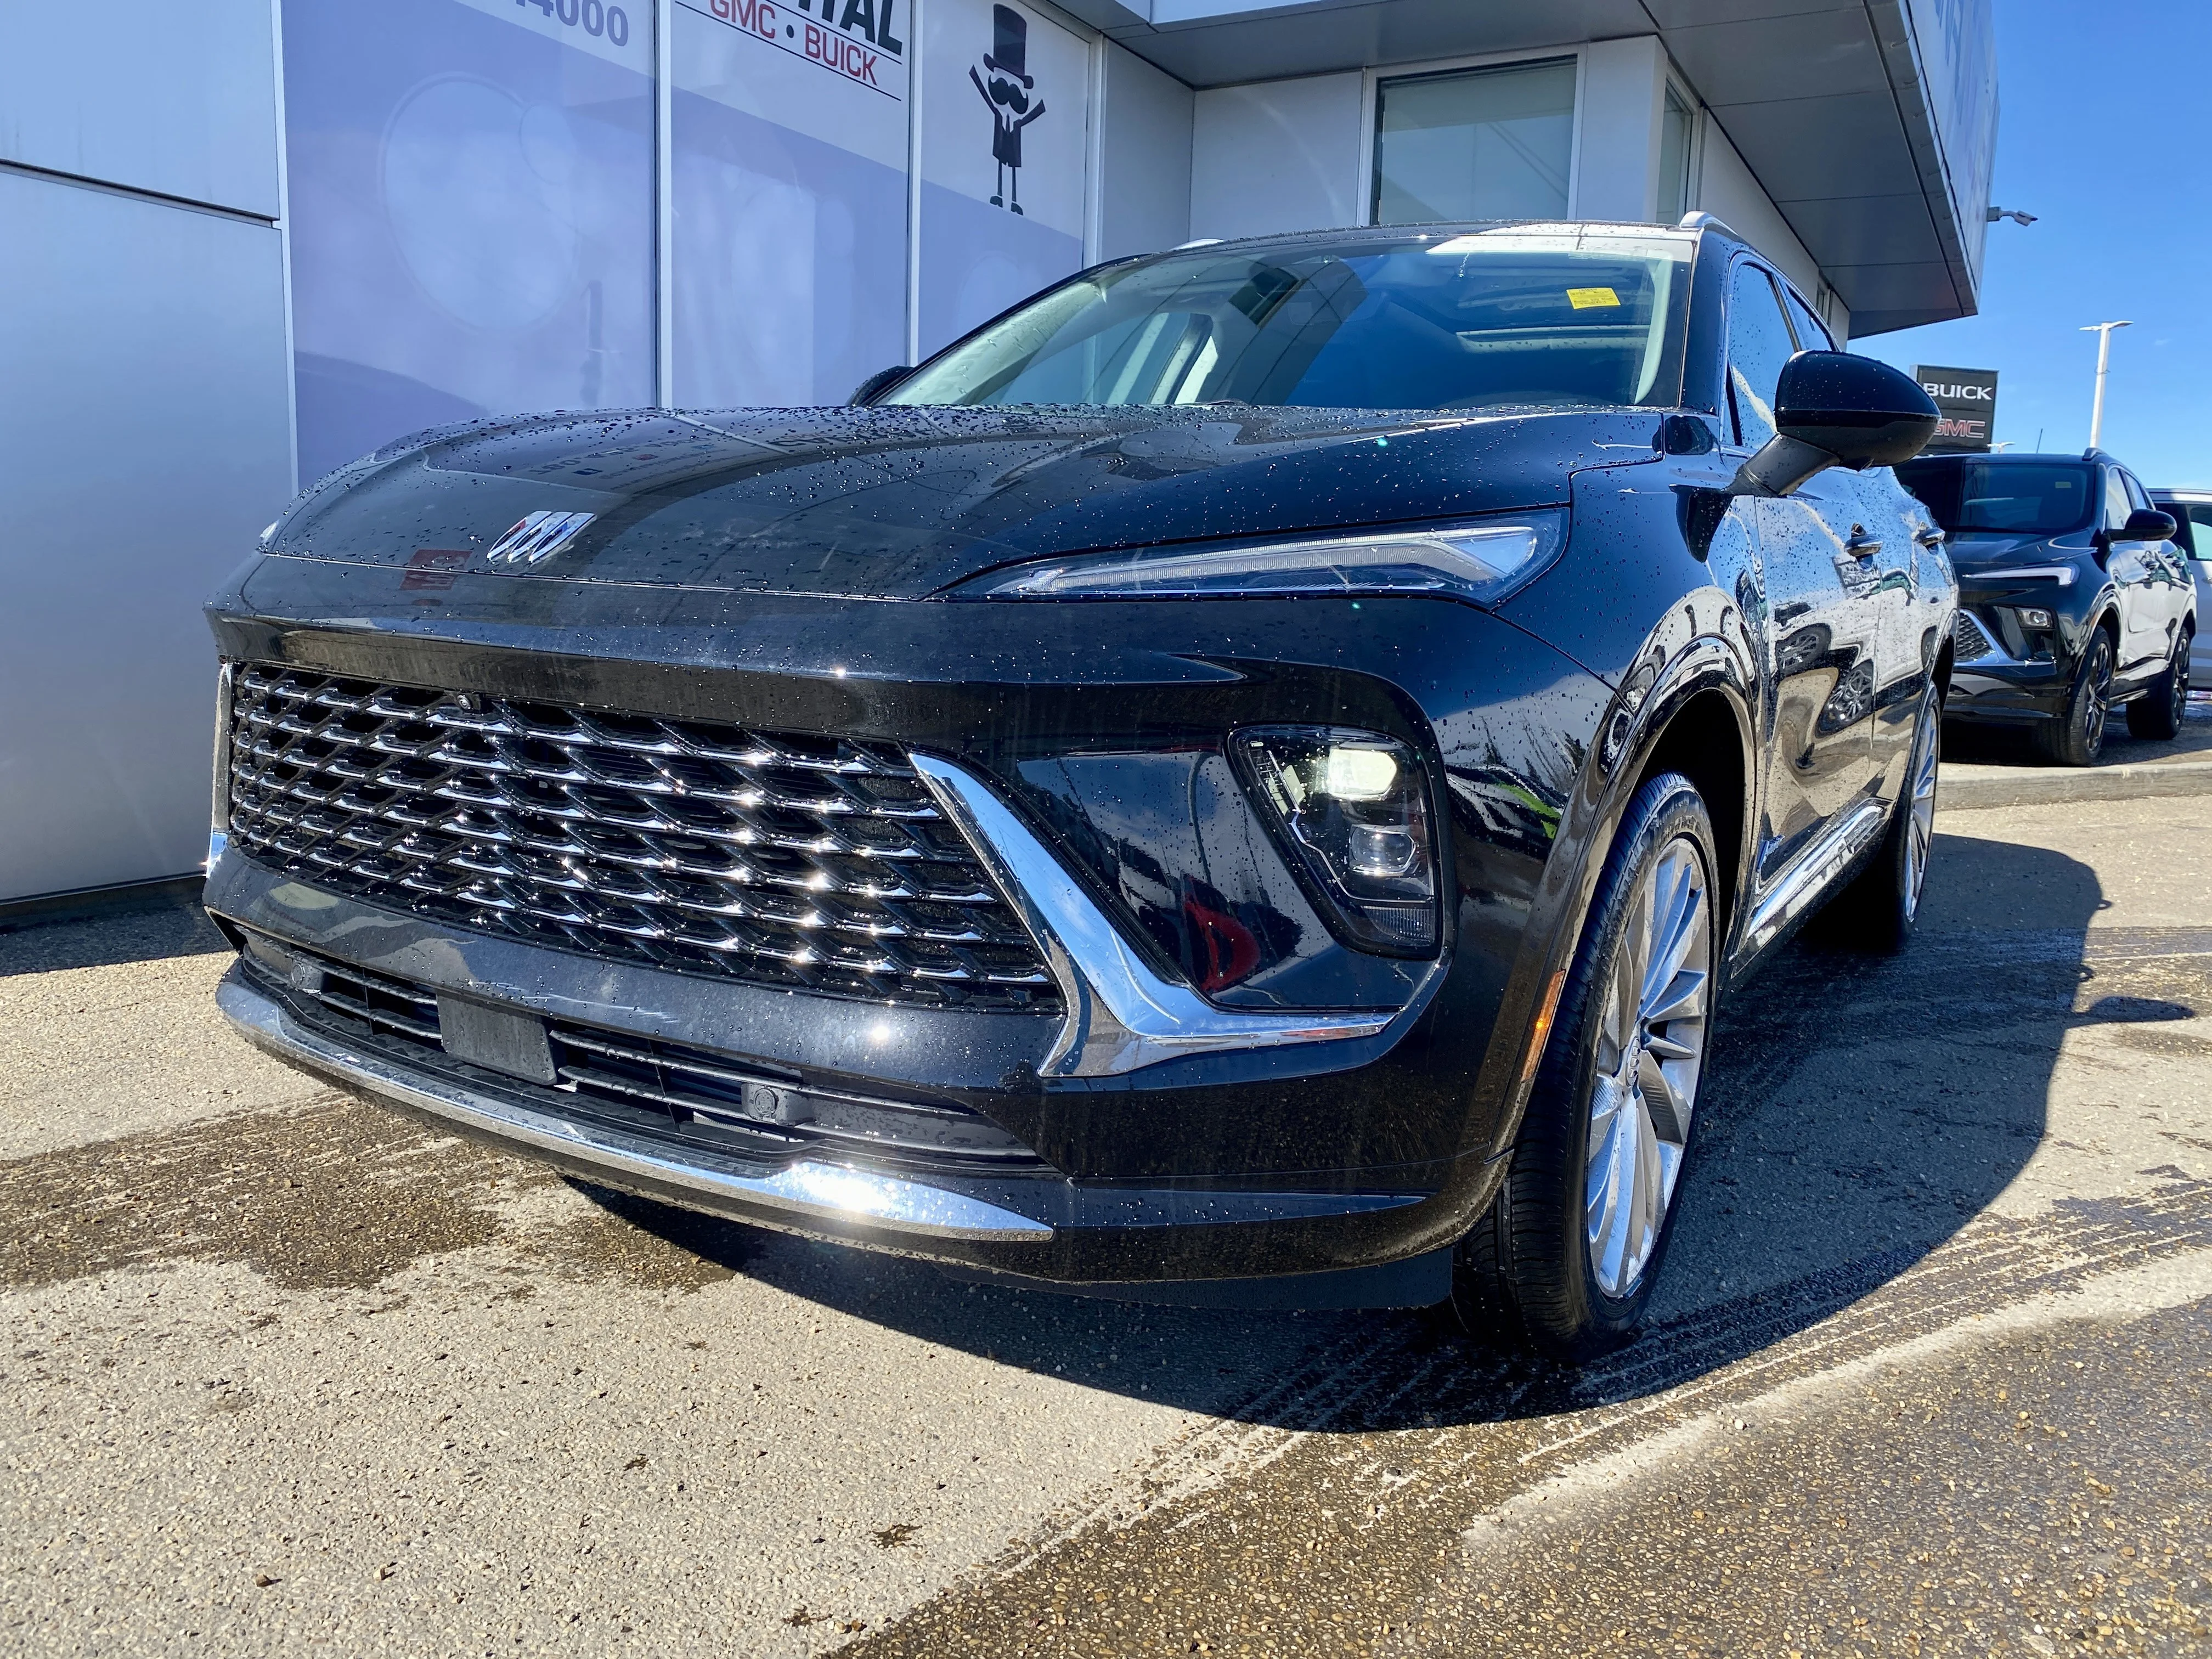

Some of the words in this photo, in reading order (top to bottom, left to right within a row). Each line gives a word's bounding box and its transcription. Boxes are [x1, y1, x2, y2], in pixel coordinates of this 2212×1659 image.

[710, 0, 776, 39] GMC
[805, 23, 878, 86] BUICK
[798, 0, 902, 56] AL
[1923, 382, 1993, 400] BUICK
